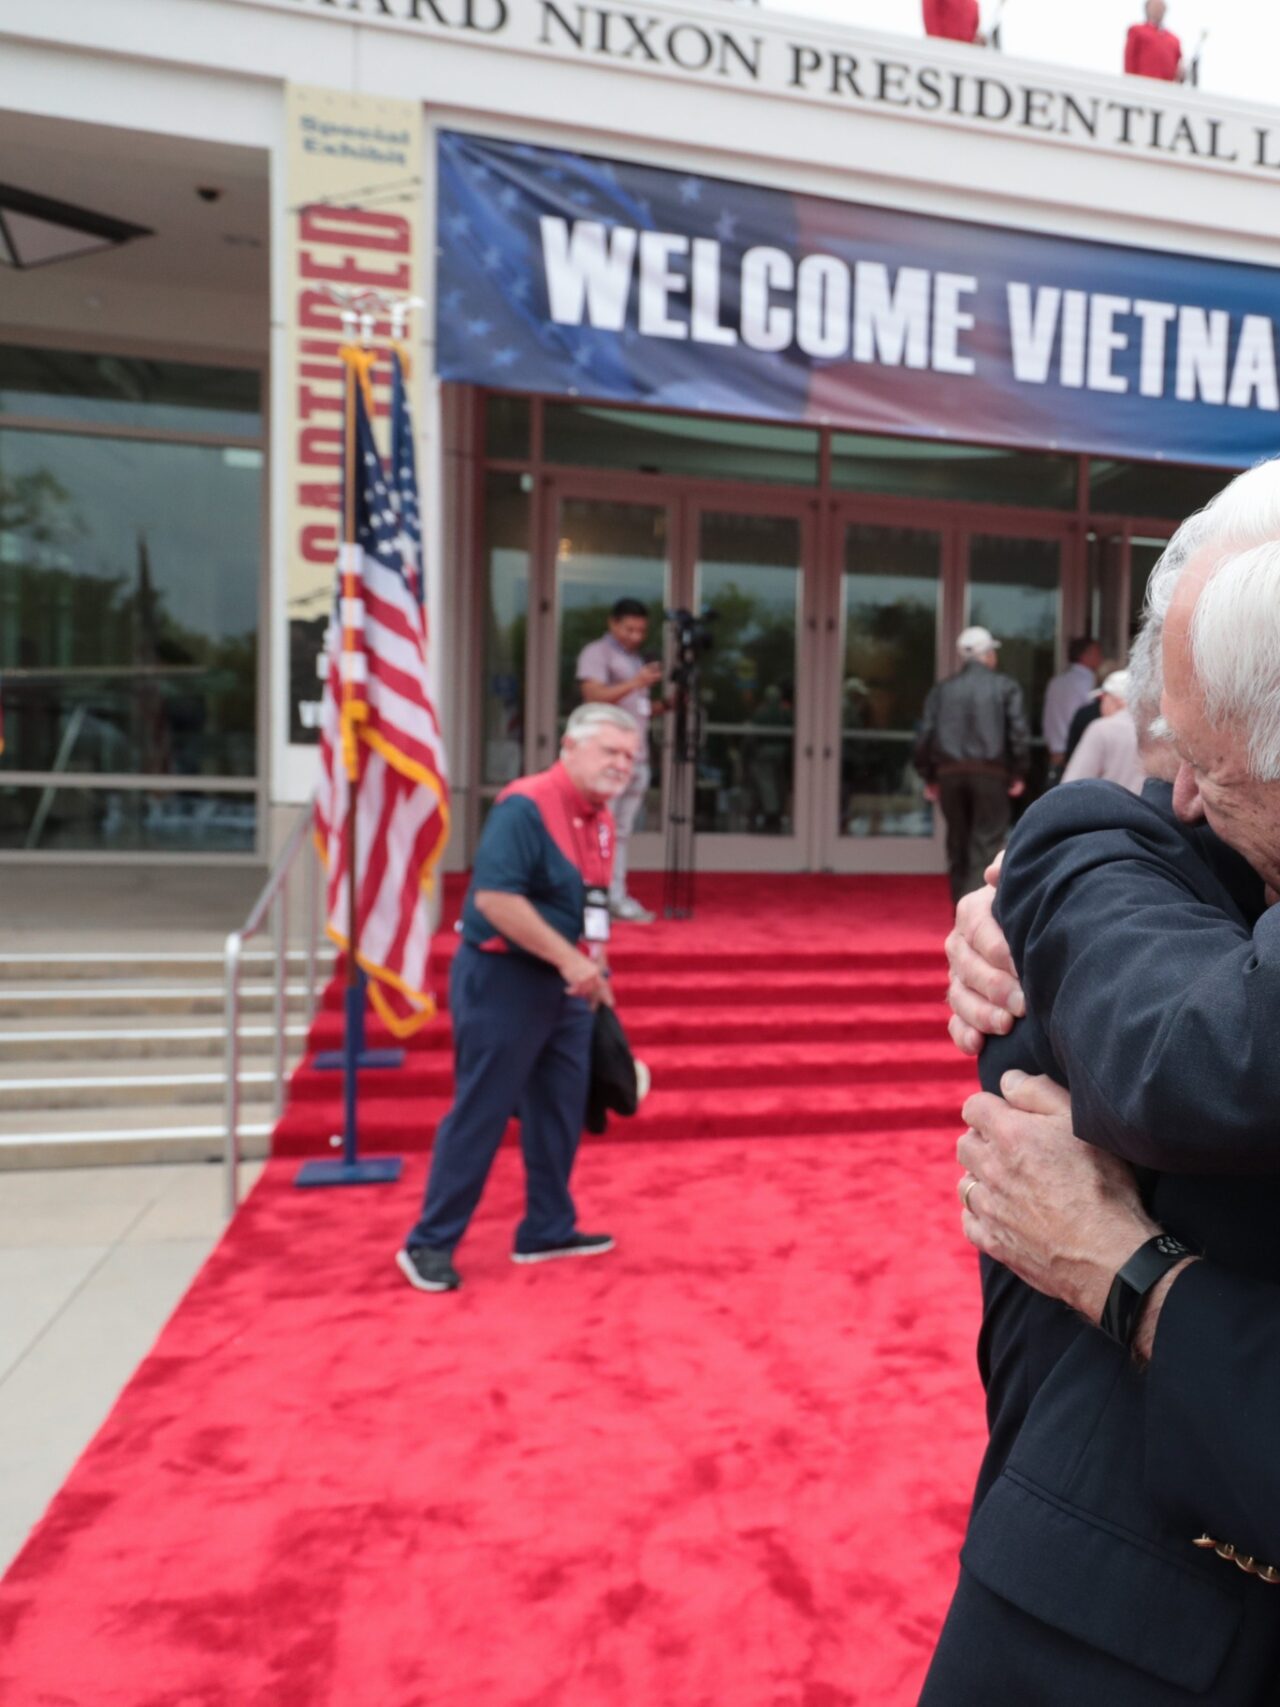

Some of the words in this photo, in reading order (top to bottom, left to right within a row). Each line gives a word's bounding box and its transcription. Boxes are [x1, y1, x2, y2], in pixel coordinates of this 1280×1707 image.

[537, 1, 763, 80] NIXON
[787, 42, 1238, 163] PRESIDENTIAL
[539, 214, 978, 376] WELCOME
